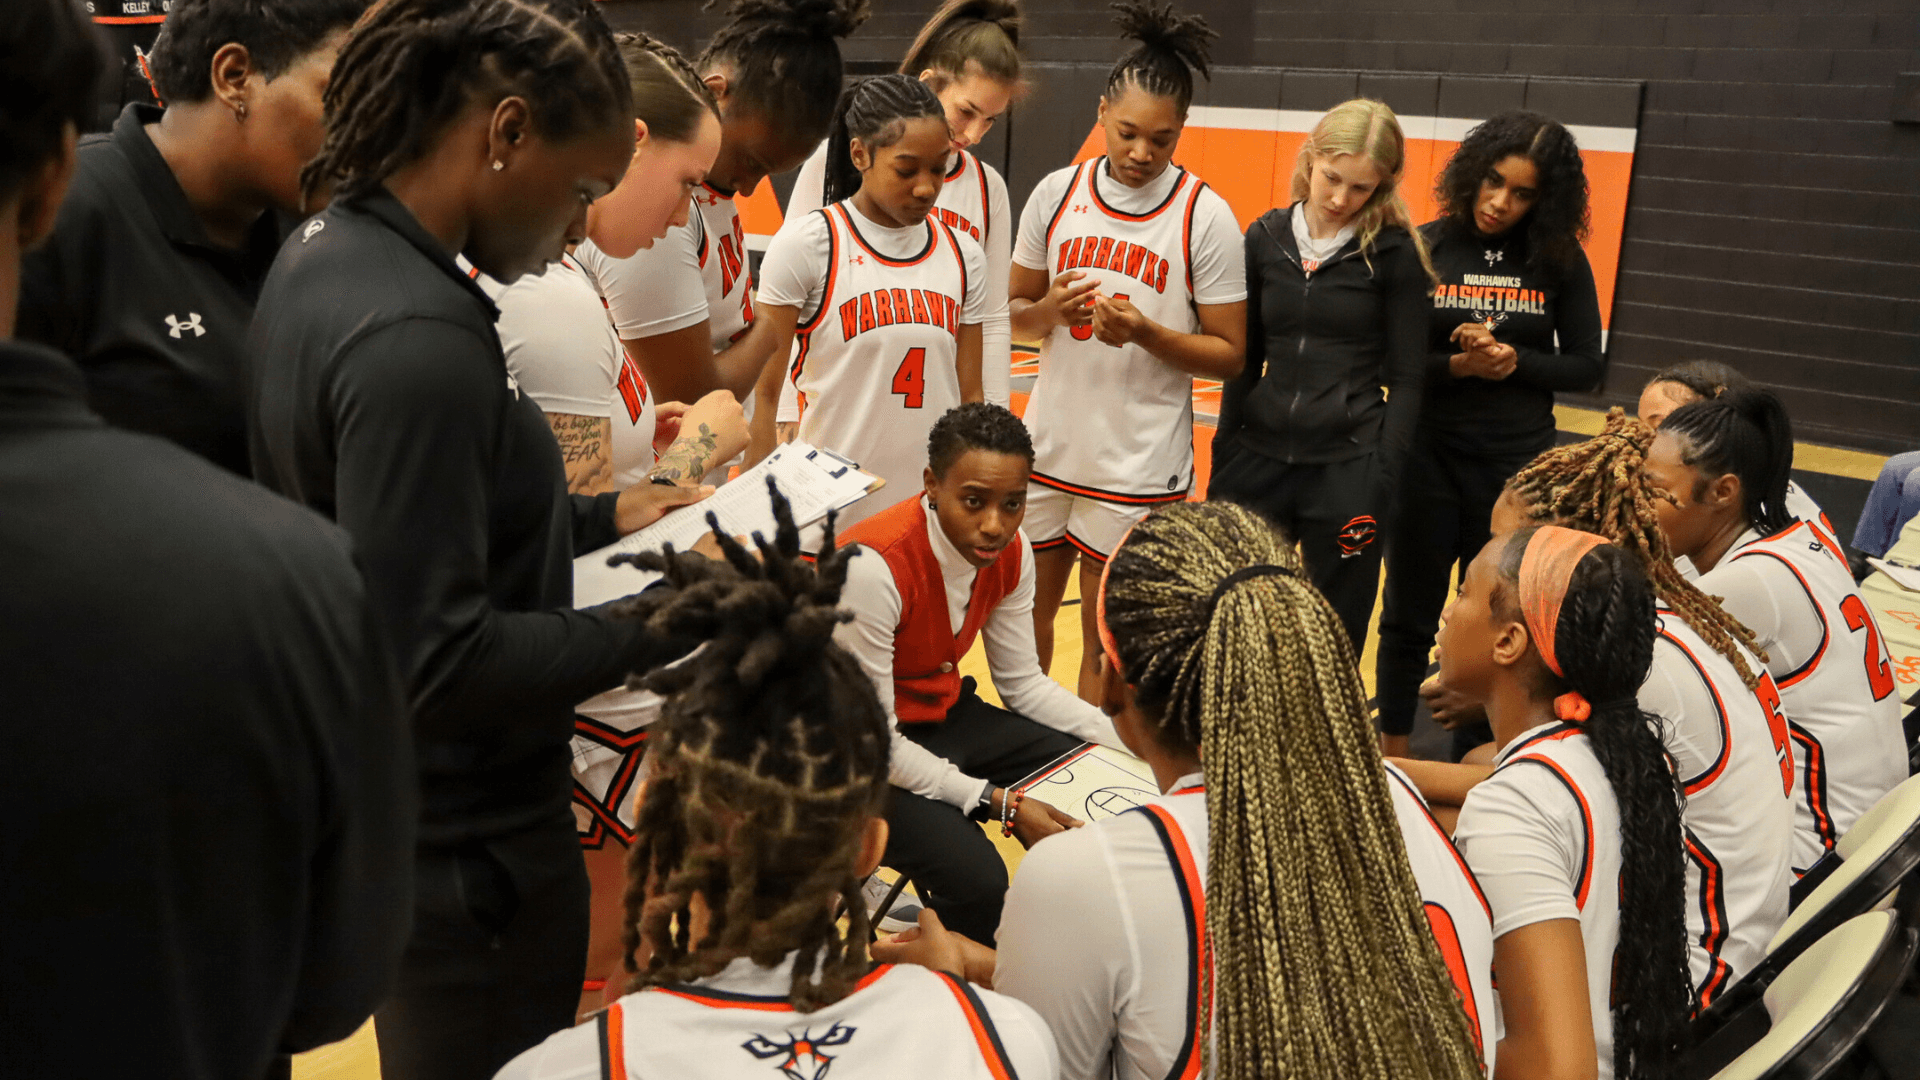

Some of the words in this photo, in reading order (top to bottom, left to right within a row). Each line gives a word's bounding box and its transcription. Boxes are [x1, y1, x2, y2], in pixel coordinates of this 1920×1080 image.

[122, 1, 150, 13] KELLEY
[1056, 236, 1169, 294] WARHAWKS
[1463, 273, 1521, 288] WARHAWKS
[1434, 284, 1545, 315] BASKETBALL
[891, 347, 926, 409] 4
